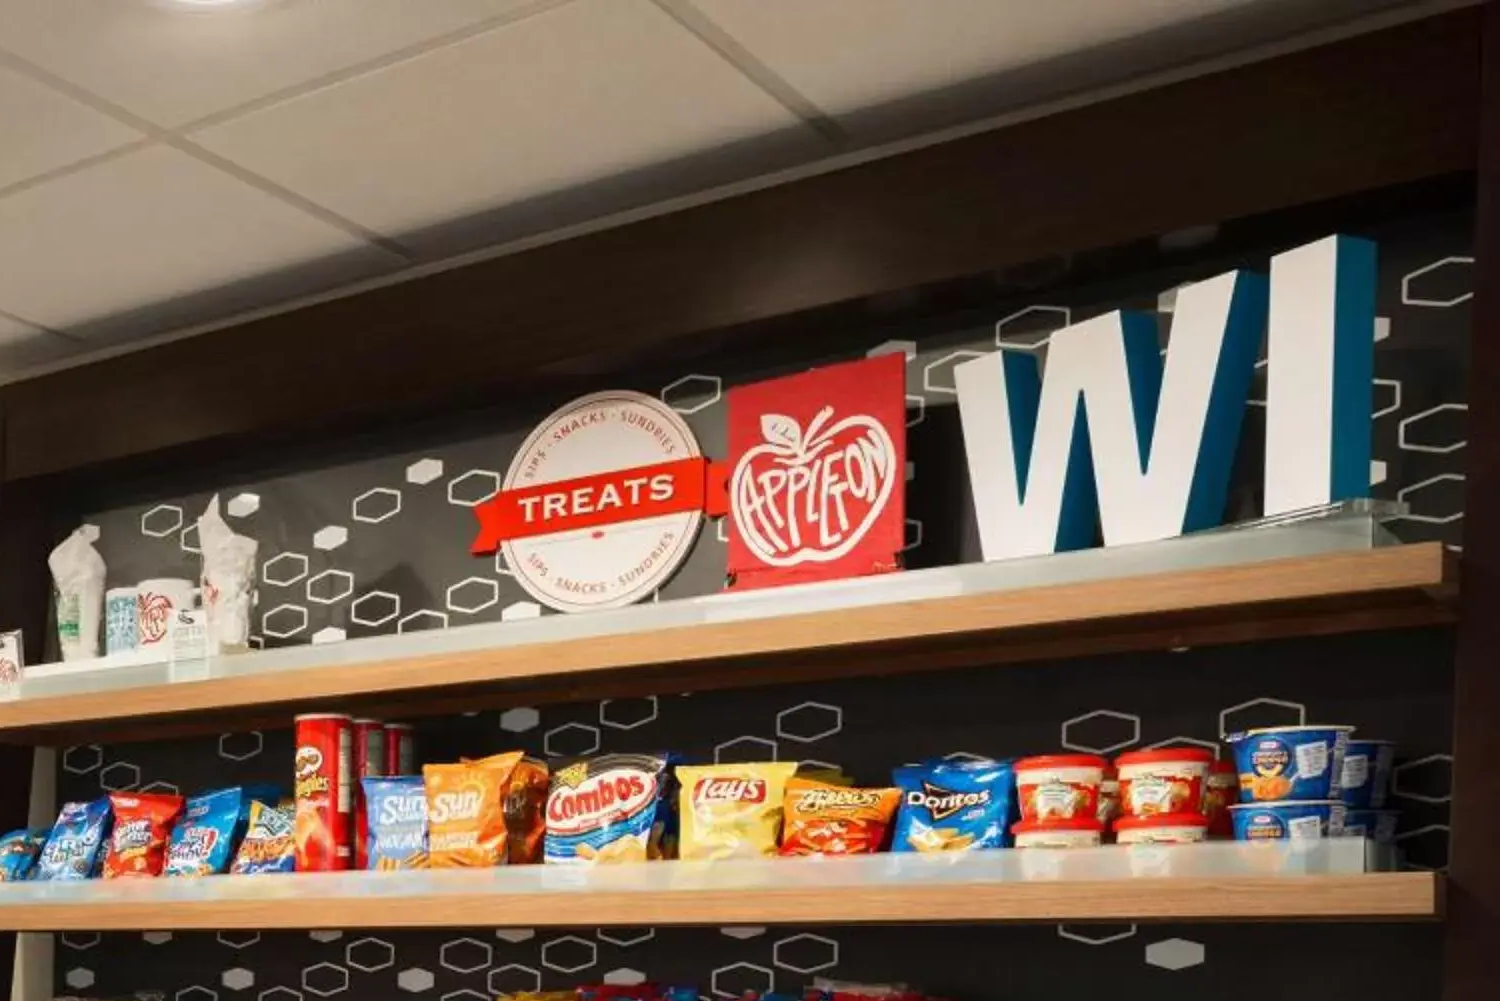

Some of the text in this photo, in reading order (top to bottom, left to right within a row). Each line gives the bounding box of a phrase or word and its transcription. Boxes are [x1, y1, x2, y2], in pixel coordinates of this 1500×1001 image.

[954, 234, 1377, 563] WI
[523, 409, 678, 480] SIPS SNACKS SUNDRIES
[517, 473, 676, 523] TREATS
[739, 428, 888, 557] APPLETON
[526, 531, 676, 595] SIPS SNACKS SUNDRIES
[548, 775, 645, 822] Combos
[906, 788, 991, 811] Doritos
